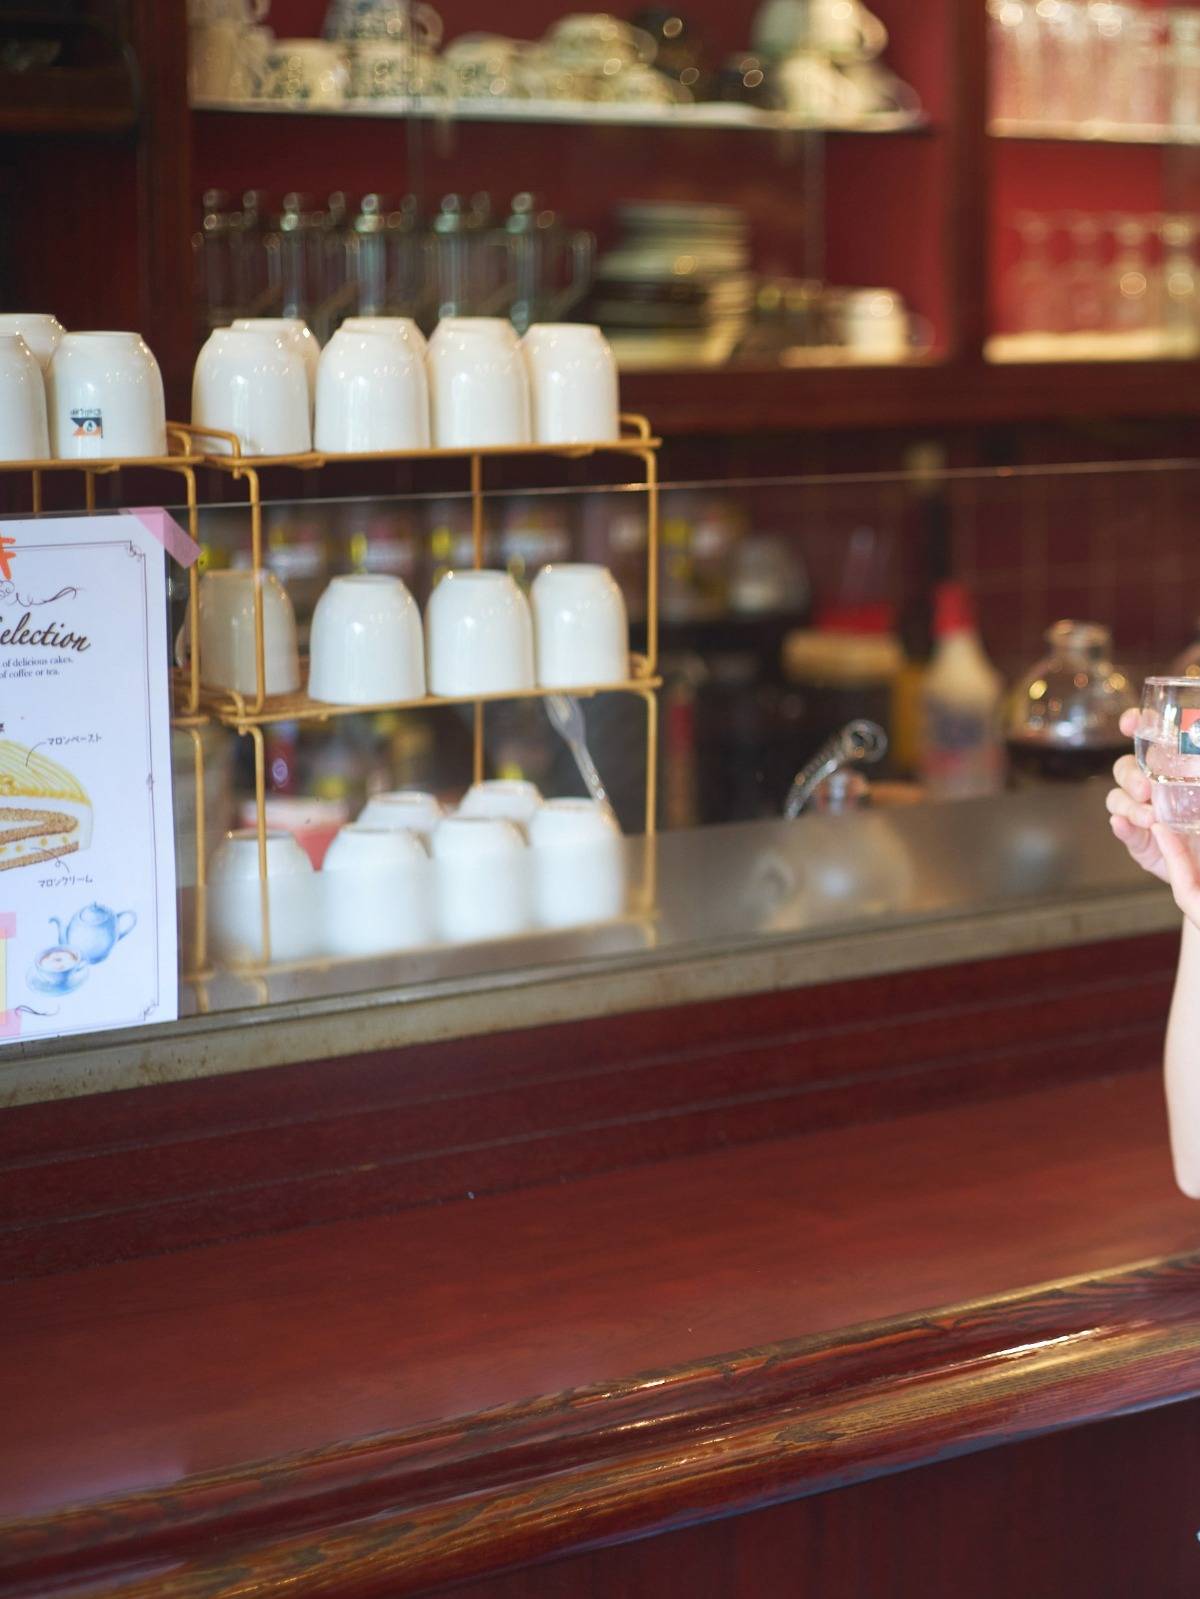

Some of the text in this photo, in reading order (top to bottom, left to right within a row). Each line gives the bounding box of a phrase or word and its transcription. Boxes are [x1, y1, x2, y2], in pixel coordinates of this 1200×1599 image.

[0, 612, 91, 652] election
[2, 658, 11, 668] of
[12, 657, 48, 668] delicious
[9, 669, 33, 678] coffee
[35, 669, 44, 677] or
